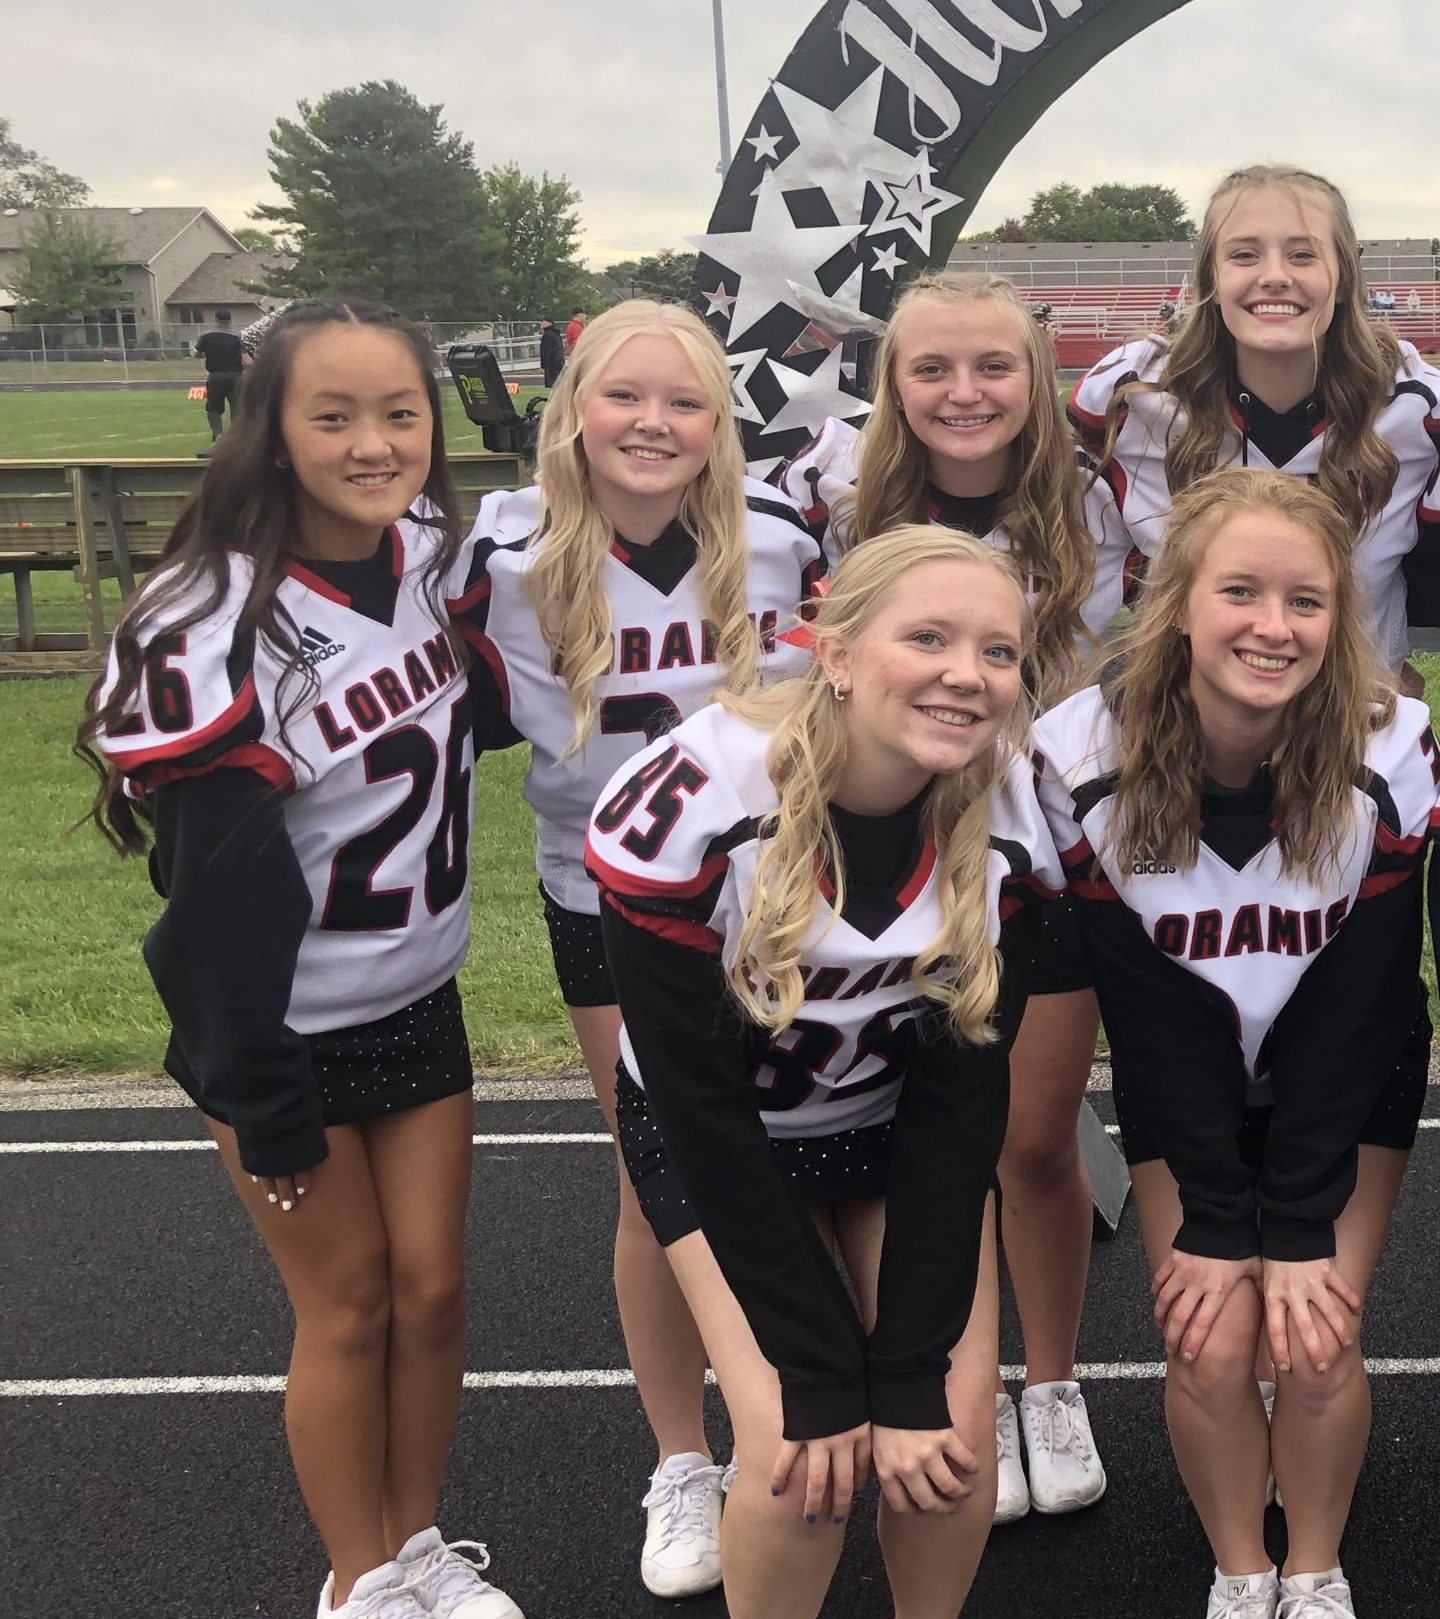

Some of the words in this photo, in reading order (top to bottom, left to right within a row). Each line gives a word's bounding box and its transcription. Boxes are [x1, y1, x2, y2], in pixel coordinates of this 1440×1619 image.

[312, 631, 460, 753] LORAM
[319, 695, 473, 931] 26
[595, 744, 709, 862] 85
[1131, 859, 1177, 875] didas
[1150, 894, 1349, 960] ORAMIE
